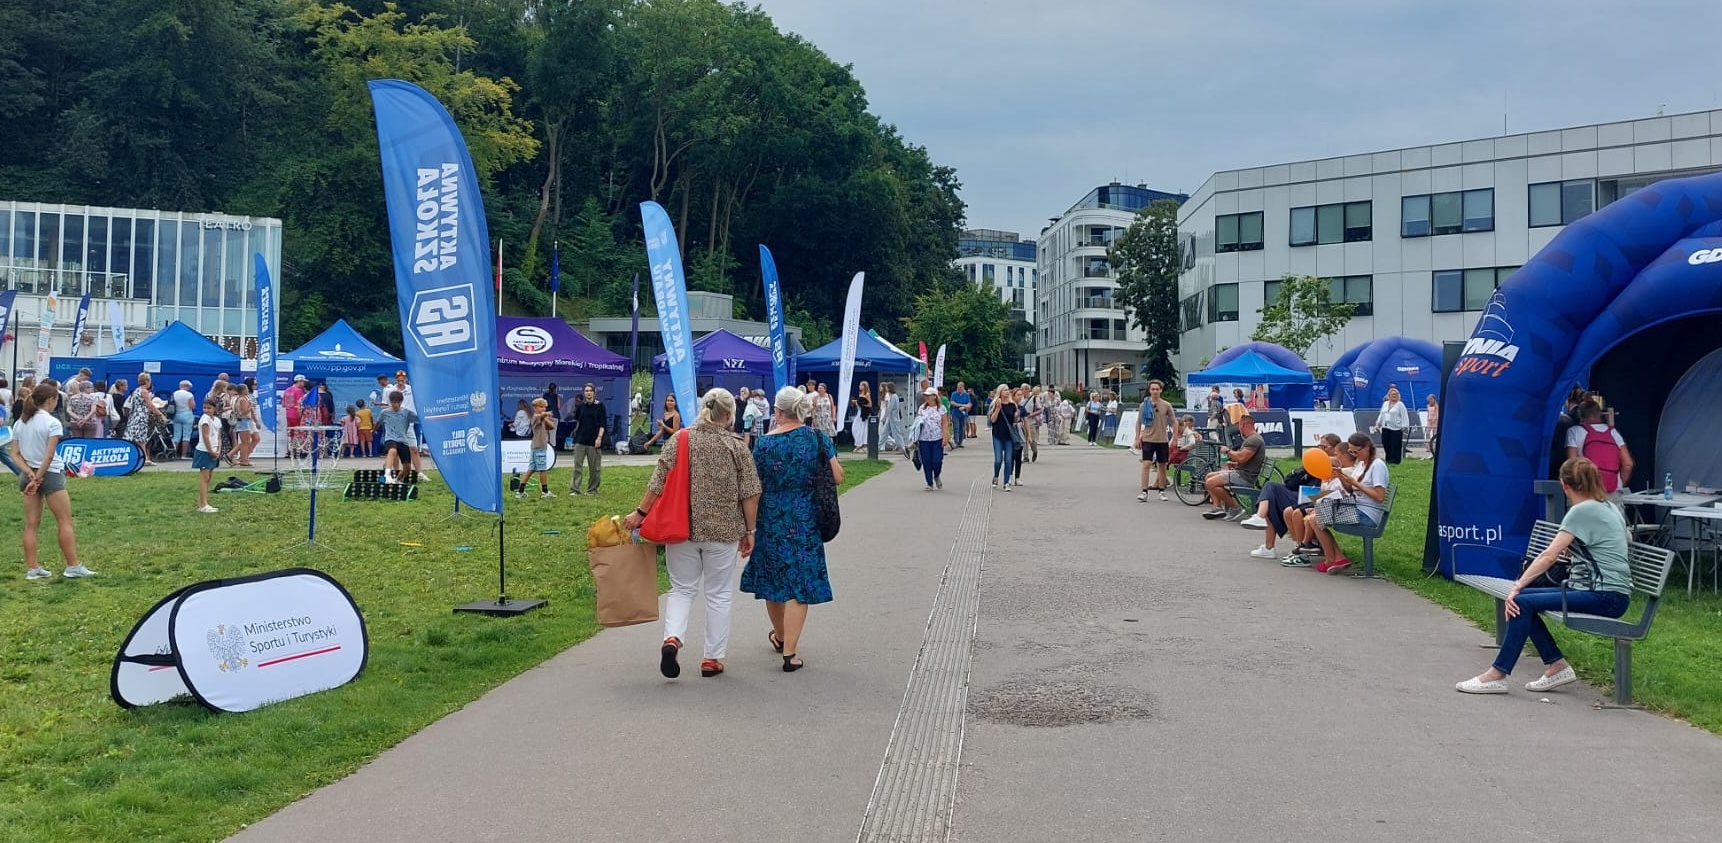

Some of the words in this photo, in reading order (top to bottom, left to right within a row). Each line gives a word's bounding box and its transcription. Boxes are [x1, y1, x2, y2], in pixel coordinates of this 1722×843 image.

[306, 363, 367, 373] www.rpp.gov.pl
[723, 359, 745, 369] NFZ
[1254, 422, 1284, 434] YNIA
[62, 446, 82, 464] AS
[91, 446, 131, 457] AKTYWNA
[90, 453, 130, 464] SZKOŁA
[1438, 524, 1503, 545] asport.pl
[244, 616, 312, 636] Ministerstwo
[250, 636, 286, 654] Sportu
[286, 633, 292, 645] i
[291, 624, 337, 644] Turystyki
